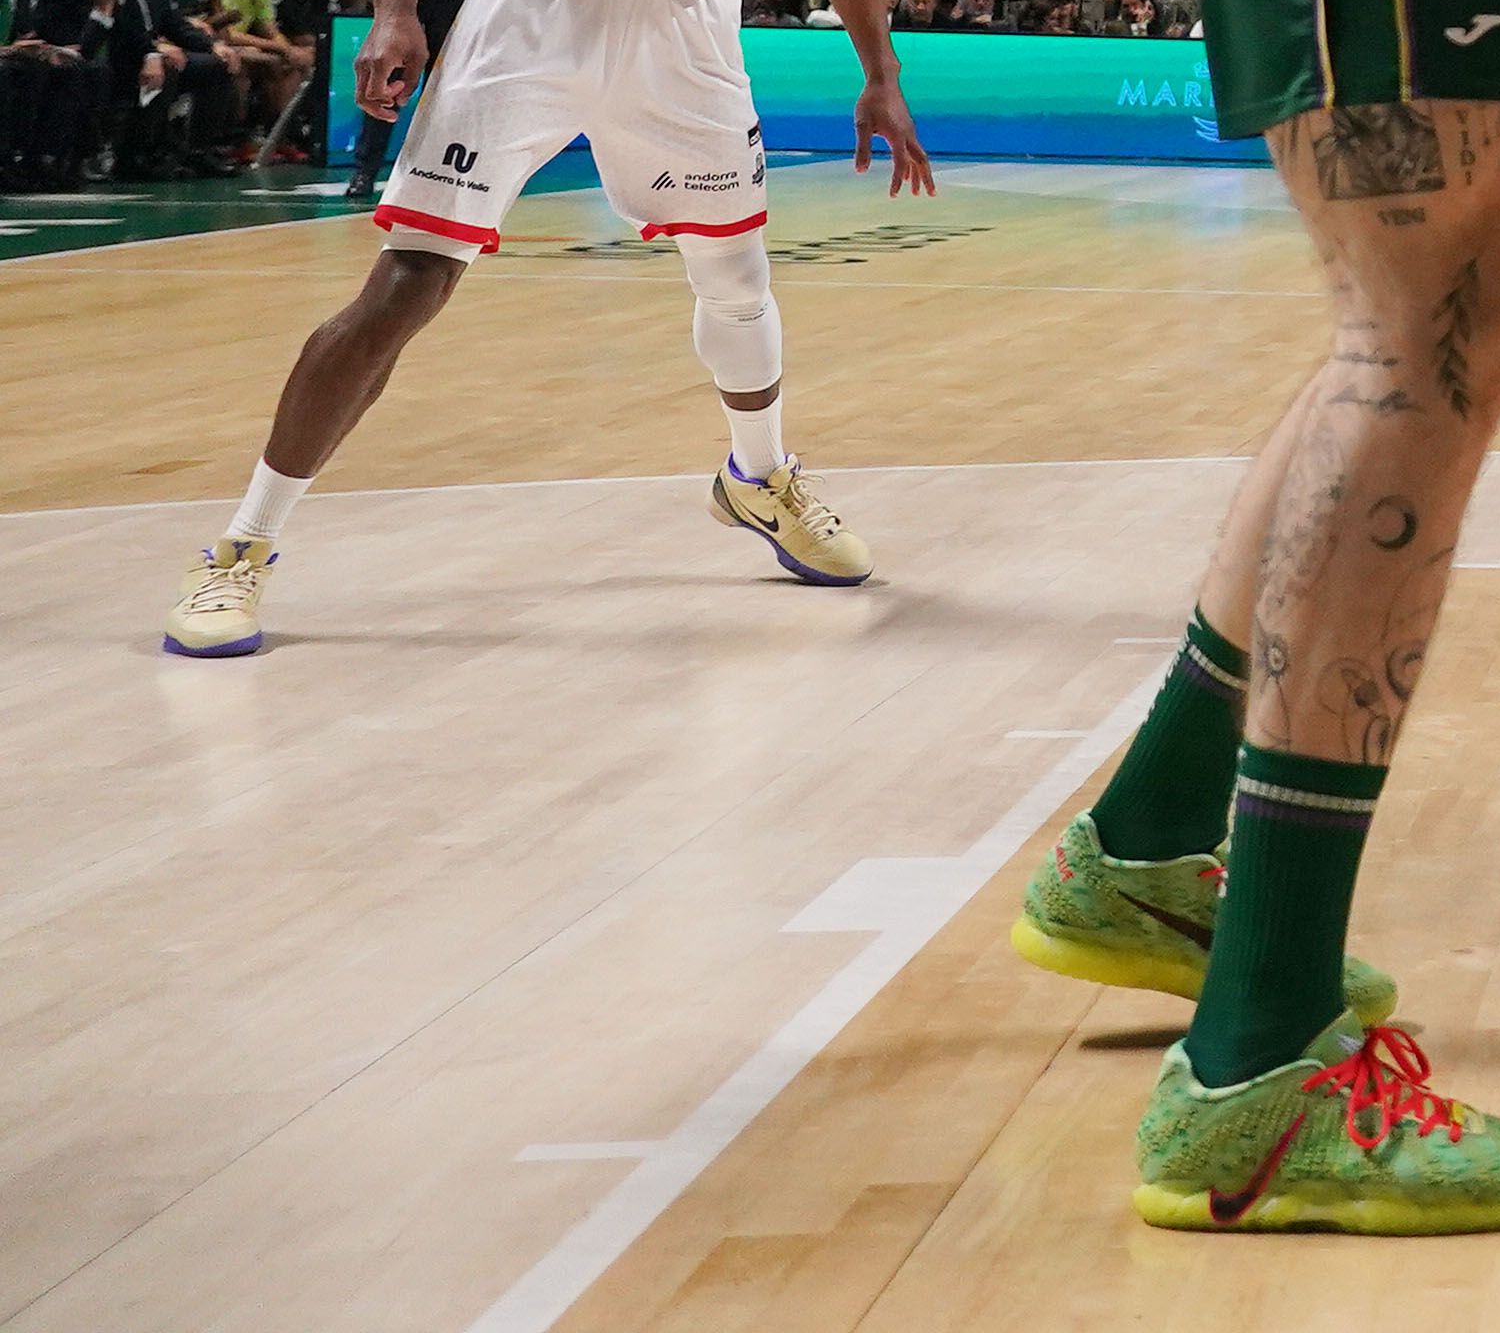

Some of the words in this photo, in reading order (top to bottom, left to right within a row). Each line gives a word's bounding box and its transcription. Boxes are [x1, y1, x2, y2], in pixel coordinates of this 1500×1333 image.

[409, 167, 455, 185] Andorra
[684, 169, 738, 181] andorra
[684, 181, 740, 192] telecom
